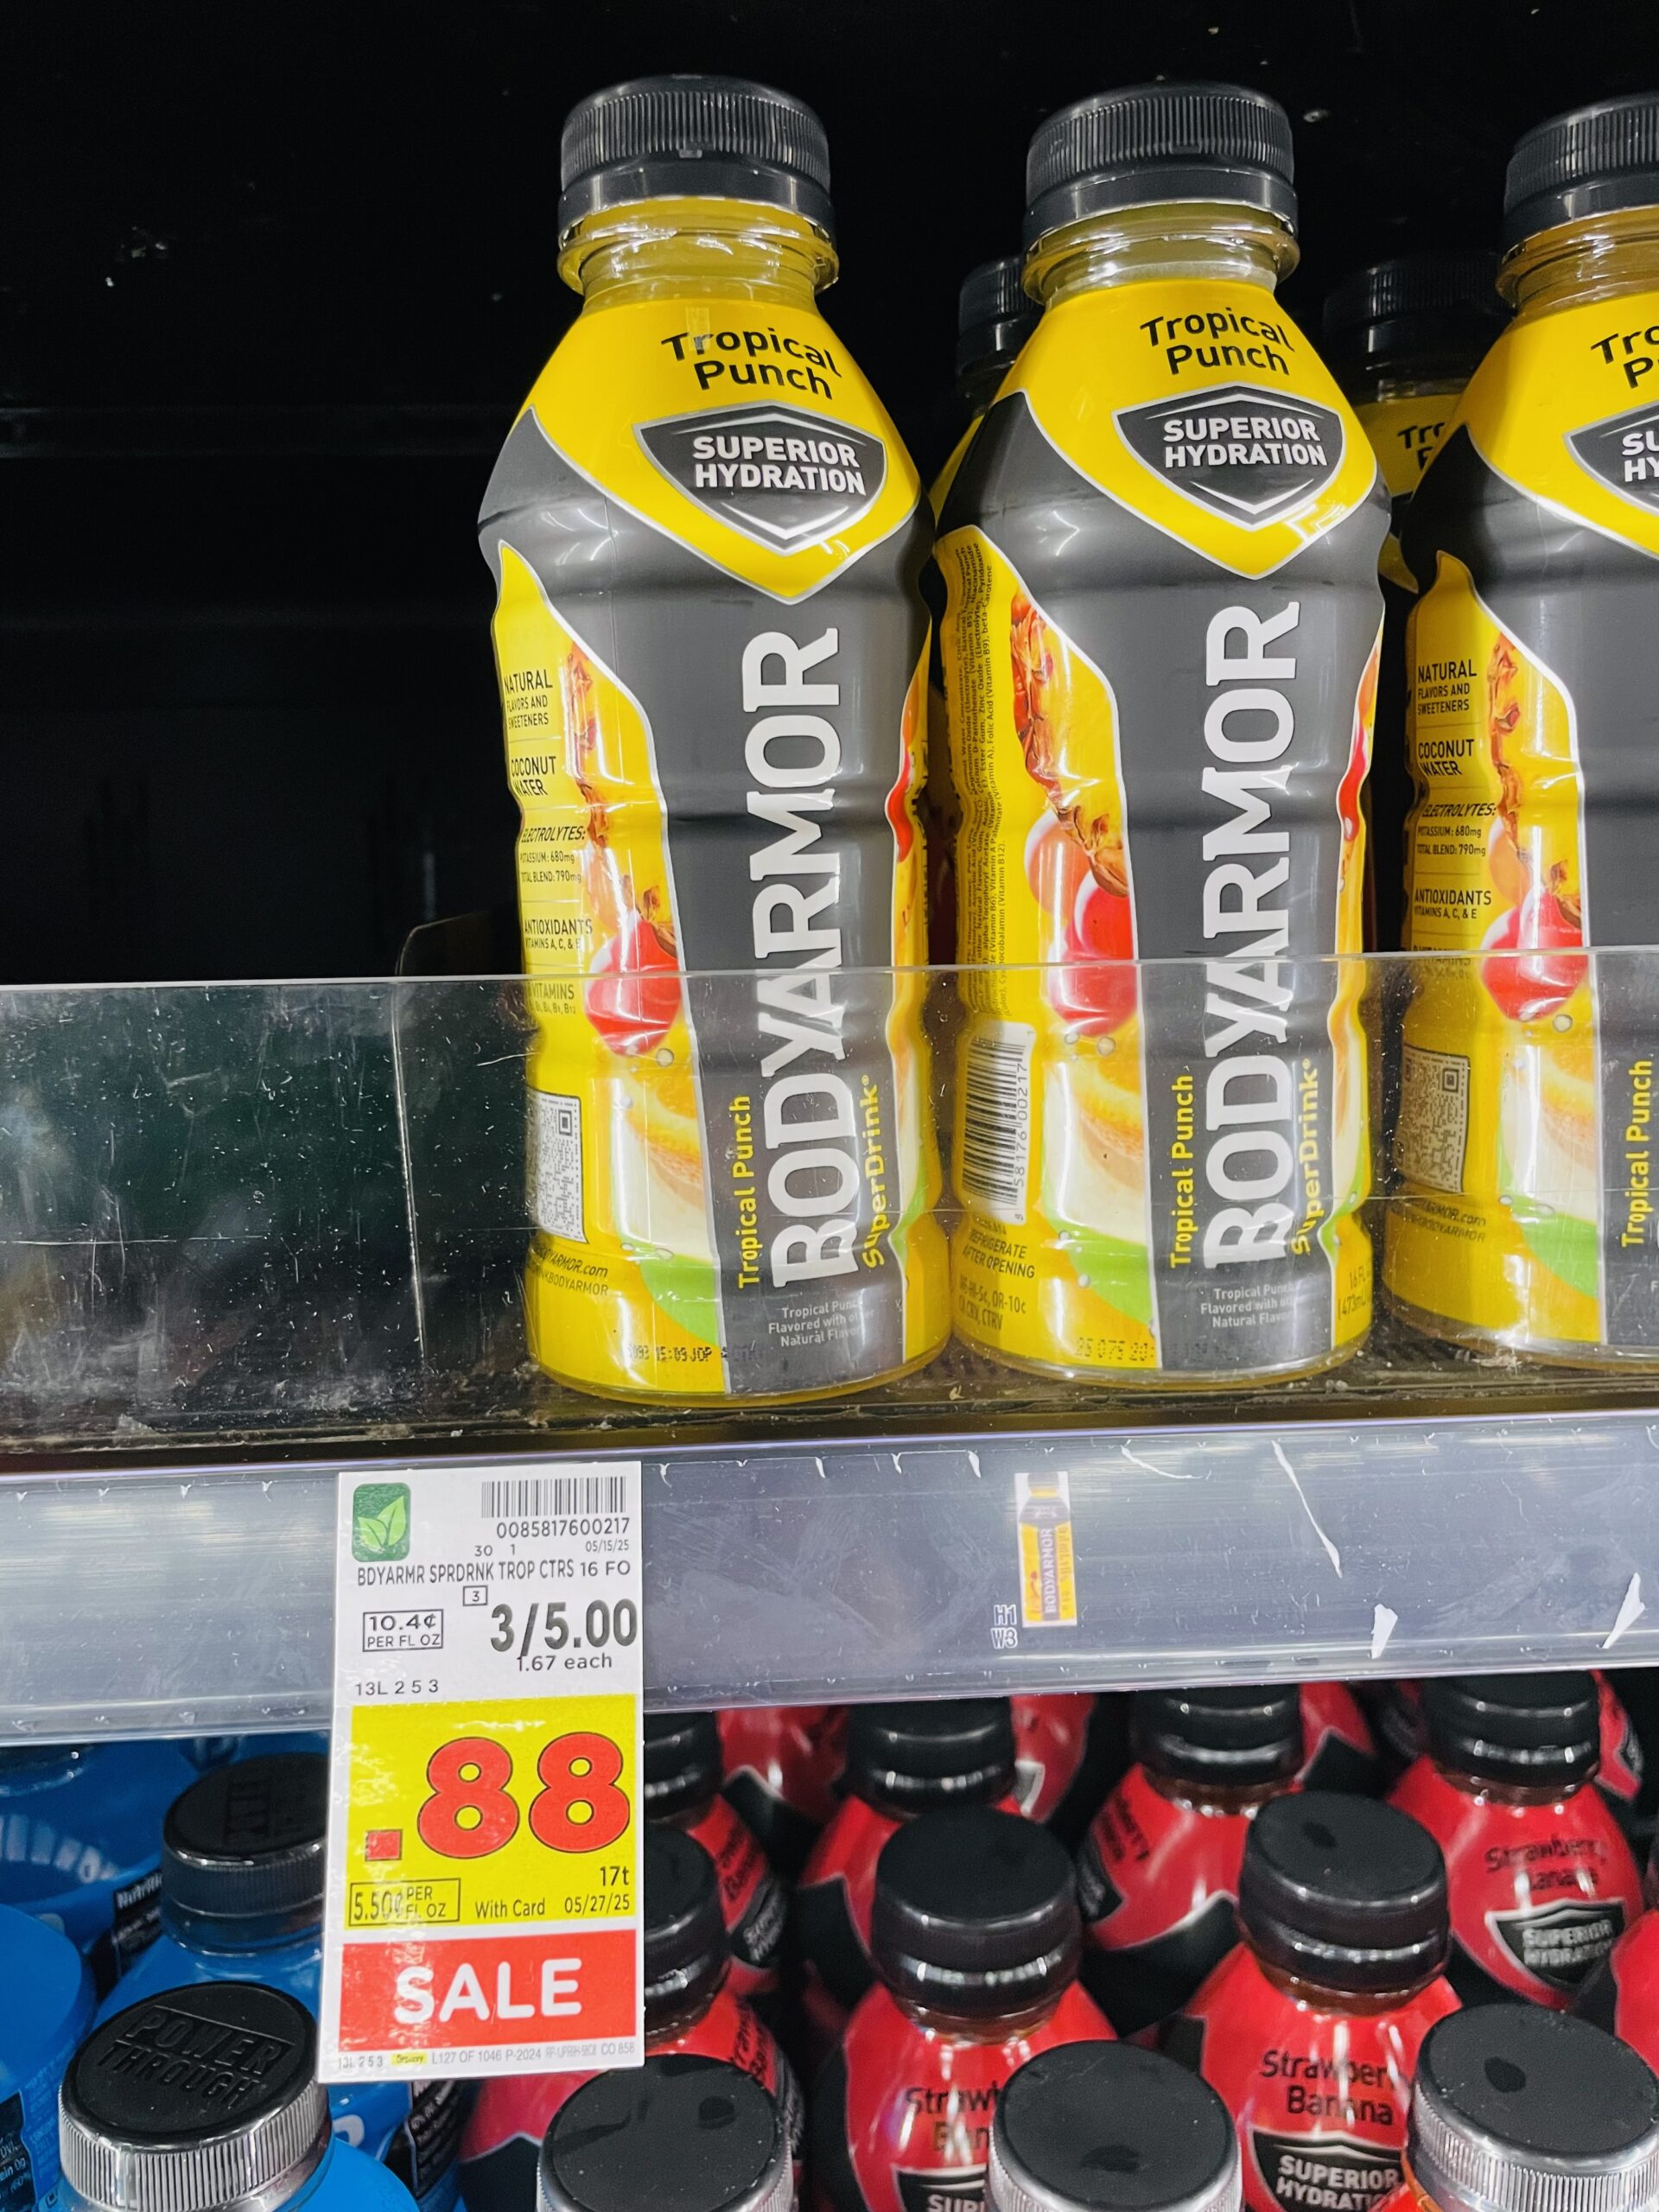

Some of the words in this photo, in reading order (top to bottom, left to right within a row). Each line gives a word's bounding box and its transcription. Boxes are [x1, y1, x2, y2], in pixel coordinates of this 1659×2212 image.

[1141, 307, 1295, 353] Tropical
[661, 327, 842, 378] Tropical
[1167, 343, 1291, 376] Punch
[694, 359, 832, 399] Punch
[1162, 416, 1320, 443] SUPERIOR
[692, 435, 860, 467] SUPERIOR
[1164, 443, 1328, 469] HYDRATION
[694, 463, 866, 496] HYDRATION
[973, 543, 985, 593] Pyridoxine
[982, 565, 992, 633] beta-Carotene
[504, 669, 553, 694] NATURAL
[985, 658, 994, 698] (Vitamin
[1418, 659, 1478, 684] NATURAL
[1418, 685, 1448, 701] FLAVORS
[1451, 683, 1470, 696] AND
[506, 697, 529, 713] FLAVORS
[531, 695, 548, 708] AND
[1418, 699, 1470, 715] SWEETENERS
[508, 713, 549, 729] SWEETENERS
[1418, 739, 1474, 759] COCONUT
[511, 756, 556, 777] COCONUT
[1420, 760, 1462, 777] WATER
[513, 779, 549, 797] WATER
[988, 763, 1001, 799] (Vitamin
[1422, 803, 1497, 817] ELECTROLYTES:
[990, 802, 1002, 843] Palmitate
[1417, 825, 1454, 836] POTASSIUM:
[1455, 825, 1481, 838] 680mg
[521, 825, 586, 843] ELECTROLYTES:
[550, 850, 575, 864] 680mg
[1433, 844, 1458, 855] BLEND:
[1459, 843, 1485, 856] 790mg
[533, 872, 555, 883] BLEND:
[556, 870, 581, 883] 790mg
[1414, 889, 1492, 905] ANTIOXIDANTS
[1414, 906, 1441, 918] VITAMINS
[1452, 908, 1460, 919] C,
[1462, 908, 1468, 918] &
[1471, 908, 1477, 918] E
[524, 918, 593, 935] ANTIOXIDANTS
[1201, 601, 1300, 1269] BODYARMOR
[525, 938, 550, 949] VITAMINS
[558, 939, 567, 950] C,
[568, 939, 574, 949] &
[741, 627, 861, 1287] BODYARMOR
[531, 982, 575, 1000] VITAMINS
[1017, 1063, 1028, 1121] 00217
[1626, 1059, 1653, 1141] Punch
[1171, 1073, 1194, 1160] Punch
[728, 1096, 754, 1179] Punch
[1621, 1150, 1654, 1248] Tropical
[1170, 1168, 1198, 1268] Tropical
[734, 1186, 763, 1289] Tropical
[969, 1229, 1027, 1259] REFRIGERATE
[986, 1255, 1035, 1279] OPENING
[1213, 1285, 1262, 1301] Tropical
[782, 1302, 830, 1319] Tropical
[832, 1300, 861, 1313] Punc
[1200, 1300, 1252, 1314] Flavored
[1254, 1298, 1278, 1311] with
[768, 1318, 820, 1334] Flavored
[823, 1313, 846, 1328] with
[1212, 1313, 1255, 1328] Natural
[781, 1331, 824, 1347] Natural
[497, 1517, 630, 1539] 0085817600217
[474, 1545, 493, 1557] 30
[511, 1543, 516, 1555] 1
[586, 1540, 629, 1553] 05/15/25
[358, 1565, 424, 1586] BDYARMR
[430, 1561, 493, 1583] SPRDRNK
[499, 1560, 535, 1581] TROP
[539, 1559, 574, 1579] CTRS
[581, 1561, 598, 1577] 16
[606, 1560, 631, 1575] FO
[1041, 1529, 1057, 1613] BODYARMOR
[473, 1591, 480, 1603] 3
[994, 1605, 1017, 1625] H1
[370, 1612, 436, 1631] 10.4¢
[490, 1599, 638, 1657] 3/5.00
[990, 1627, 1018, 1649] W3
[367, 1636, 393, 1648] PER
[399, 1635, 415, 1647] FL
[421, 1634, 441, 1646] OZ
[517, 1655, 556, 1672] 1.67
[564, 1653, 612, 1669] each
[355, 1681, 388, 1695] 13L
[395, 1681, 404, 1694] 2
[411, 1680, 421, 1694] 5
[429, 1679, 439, 1693] 3
[365, 1732, 630, 1860] .88
[600, 1866, 629, 1887] 17t
[406, 1886, 432, 1900] PER
[427, 1903, 446, 1917] OZ
[475, 1901, 507, 1919] With
[513, 1897, 545, 1916] Card
[564, 1893, 630, 1916] 05/27/25
[394, 1957, 582, 2024] SALE
[124, 2011, 293, 2075] POWER
[432, 2051, 455, 2064] L127
[460, 2051, 474, 2063] OF
[478, 2050, 501, 2062] 1046
[505, 2048, 541, 2061] P-2024
[601, 2044, 615, 2055] CO
[618, 2042, 635, 2054] 858
[97, 2039, 261, 2109] THROUGH
[1279, 2155, 1400, 2190] SUPERIOR
